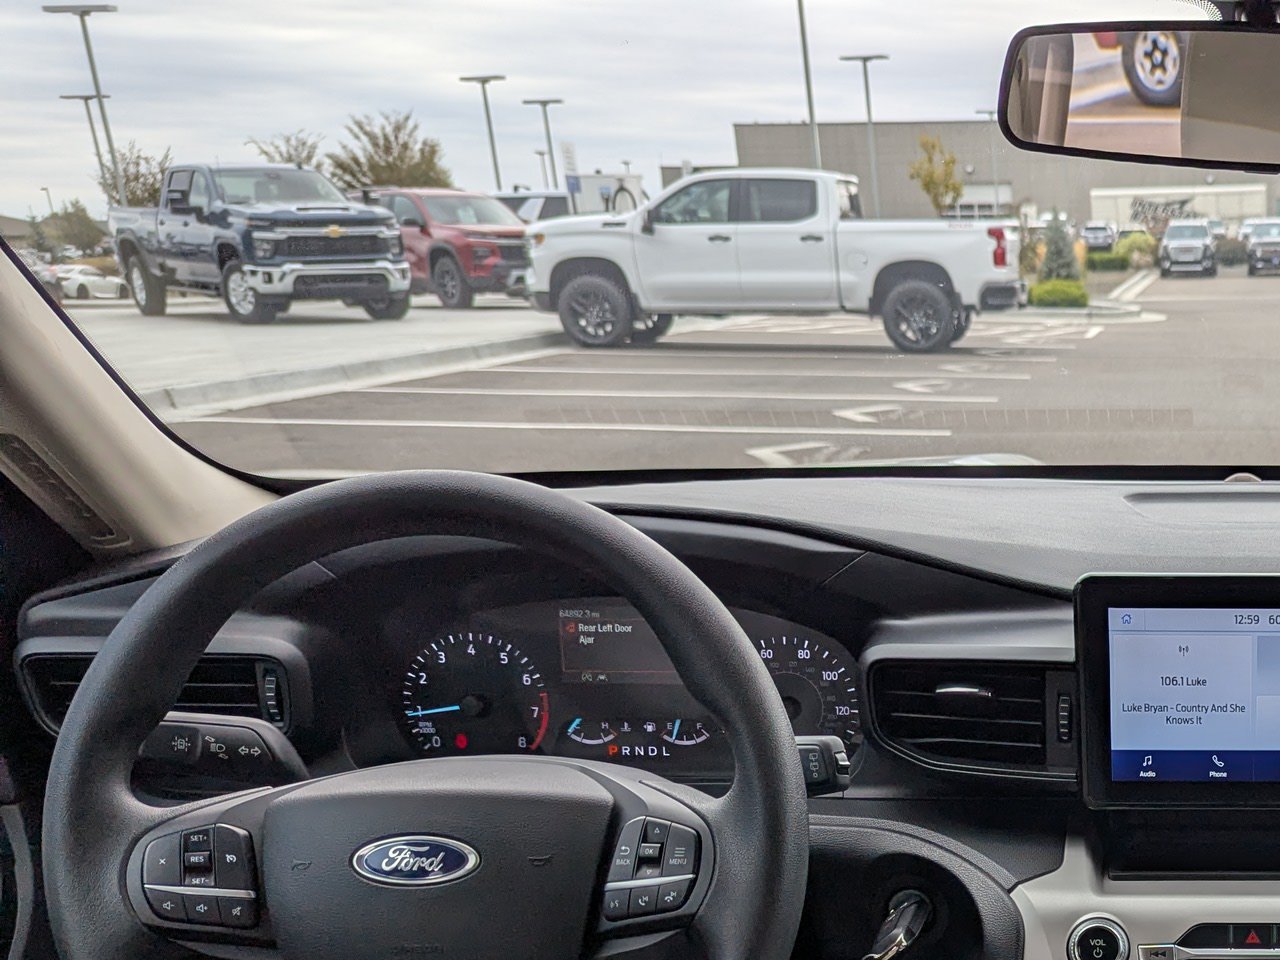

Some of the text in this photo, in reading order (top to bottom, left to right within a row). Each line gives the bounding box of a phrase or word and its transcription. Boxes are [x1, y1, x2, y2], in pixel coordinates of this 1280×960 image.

[1234, 614, 1260, 625] 12:59
[578, 623, 633, 633] Rear Left Door
[579, 635, 595, 645] Ajar
[467, 644, 476, 655] 4
[760, 649, 773, 659] 60
[797, 649, 811, 659] 80
[438, 651, 446, 663] 3
[500, 652, 509, 664] 5
[419, 672, 427, 684] 2
[522, 674, 531, 685] 6
[821, 670, 839, 681] 100
[1160, 676, 1207, 687] 106.1 Luke
[530, 706, 539, 718] 7
[835, 706, 850, 716] 120
[1122, 703, 1142, 713] Luke
[1143, 703, 1169, 714] Bryan
[1175, 703, 1209, 714] Country
[1210, 703, 1228, 713] And
[1229, 703, 1246, 713] She
[1165, 716, 1194, 725] Knows
[601, 722, 609, 730] H
[667, 722, 673, 730] E
[696, 722, 702, 730] F
[432, 736, 441, 747] 0
[518, 736, 527, 748] 8
[608, 745, 671, 756] P R N D L
[1139, 770, 1156, 778] Audio
[1209, 770, 1227, 778] Phone
[190, 855, 204, 863] RES
[380, 844, 444, 873] Ford
[615, 858, 631, 866] BACK
[1089, 938, 1106, 946] VOL
